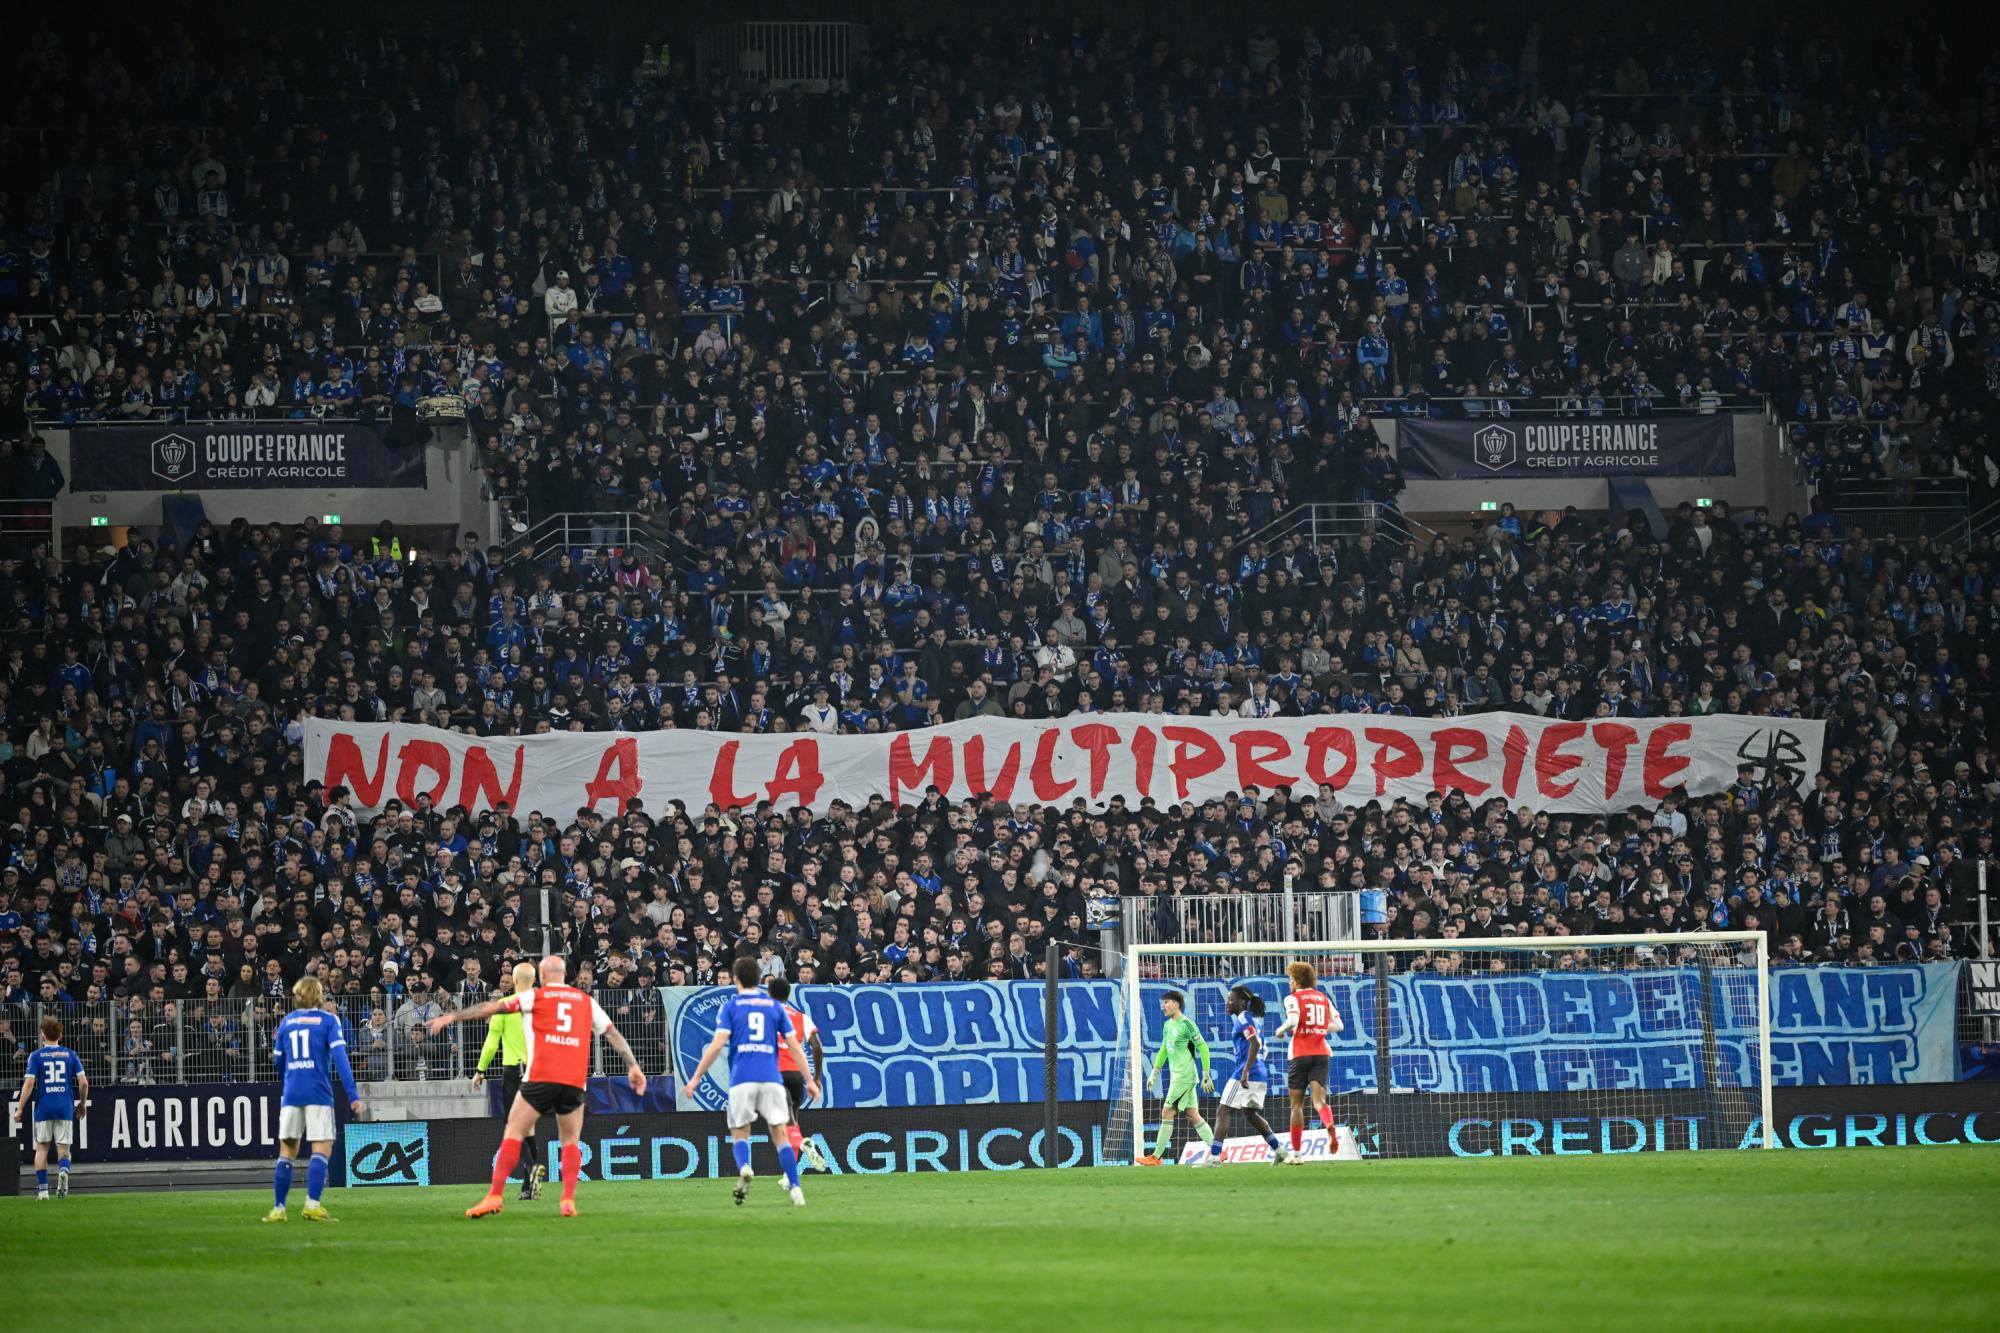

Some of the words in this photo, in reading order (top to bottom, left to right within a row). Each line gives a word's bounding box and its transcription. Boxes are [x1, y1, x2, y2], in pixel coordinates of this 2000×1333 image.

[206, 434, 264, 462] COUPE
[266, 435, 274, 462] DE
[276, 434, 346, 462] FRANCE
[1525, 425, 1580, 452] COUPE
[1583, 425, 1590, 451] DE
[1592, 424, 1658, 451] FRANCE
[206, 466, 264, 478] CRÉDIT
[267, 466, 346, 478] AGRICOLE
[1526, 454, 1580, 467] CRÉDIT
[1584, 455, 1659, 466] AGRICOLE
[323, 731, 524, 815] NON
[585, 737, 643, 815] A
[709, 738, 825, 812] LA
[889, 721, 1692, 812] MULTIPROPRIETE
[1971, 962, 2000, 988] N
[556, 1002, 572, 1032] 5
[692, 994, 729, 1016] RACING
[803, 985, 1001, 1049] POUR
[1016, 984, 1122, 1047] UN
[1418, 970, 1917, 1042] INDEPENDANT
[1305, 1003, 1325, 1026] 30
[748, 1012, 765, 1041] 9
[289, 1029, 310, 1059] 11
[545, 1034, 579, 1047] PALLOIS
[44, 1061, 66, 1084] 32
[46, 1086, 65, 1094] BARCO
[111, 1096, 284, 1150] AGRICOL
